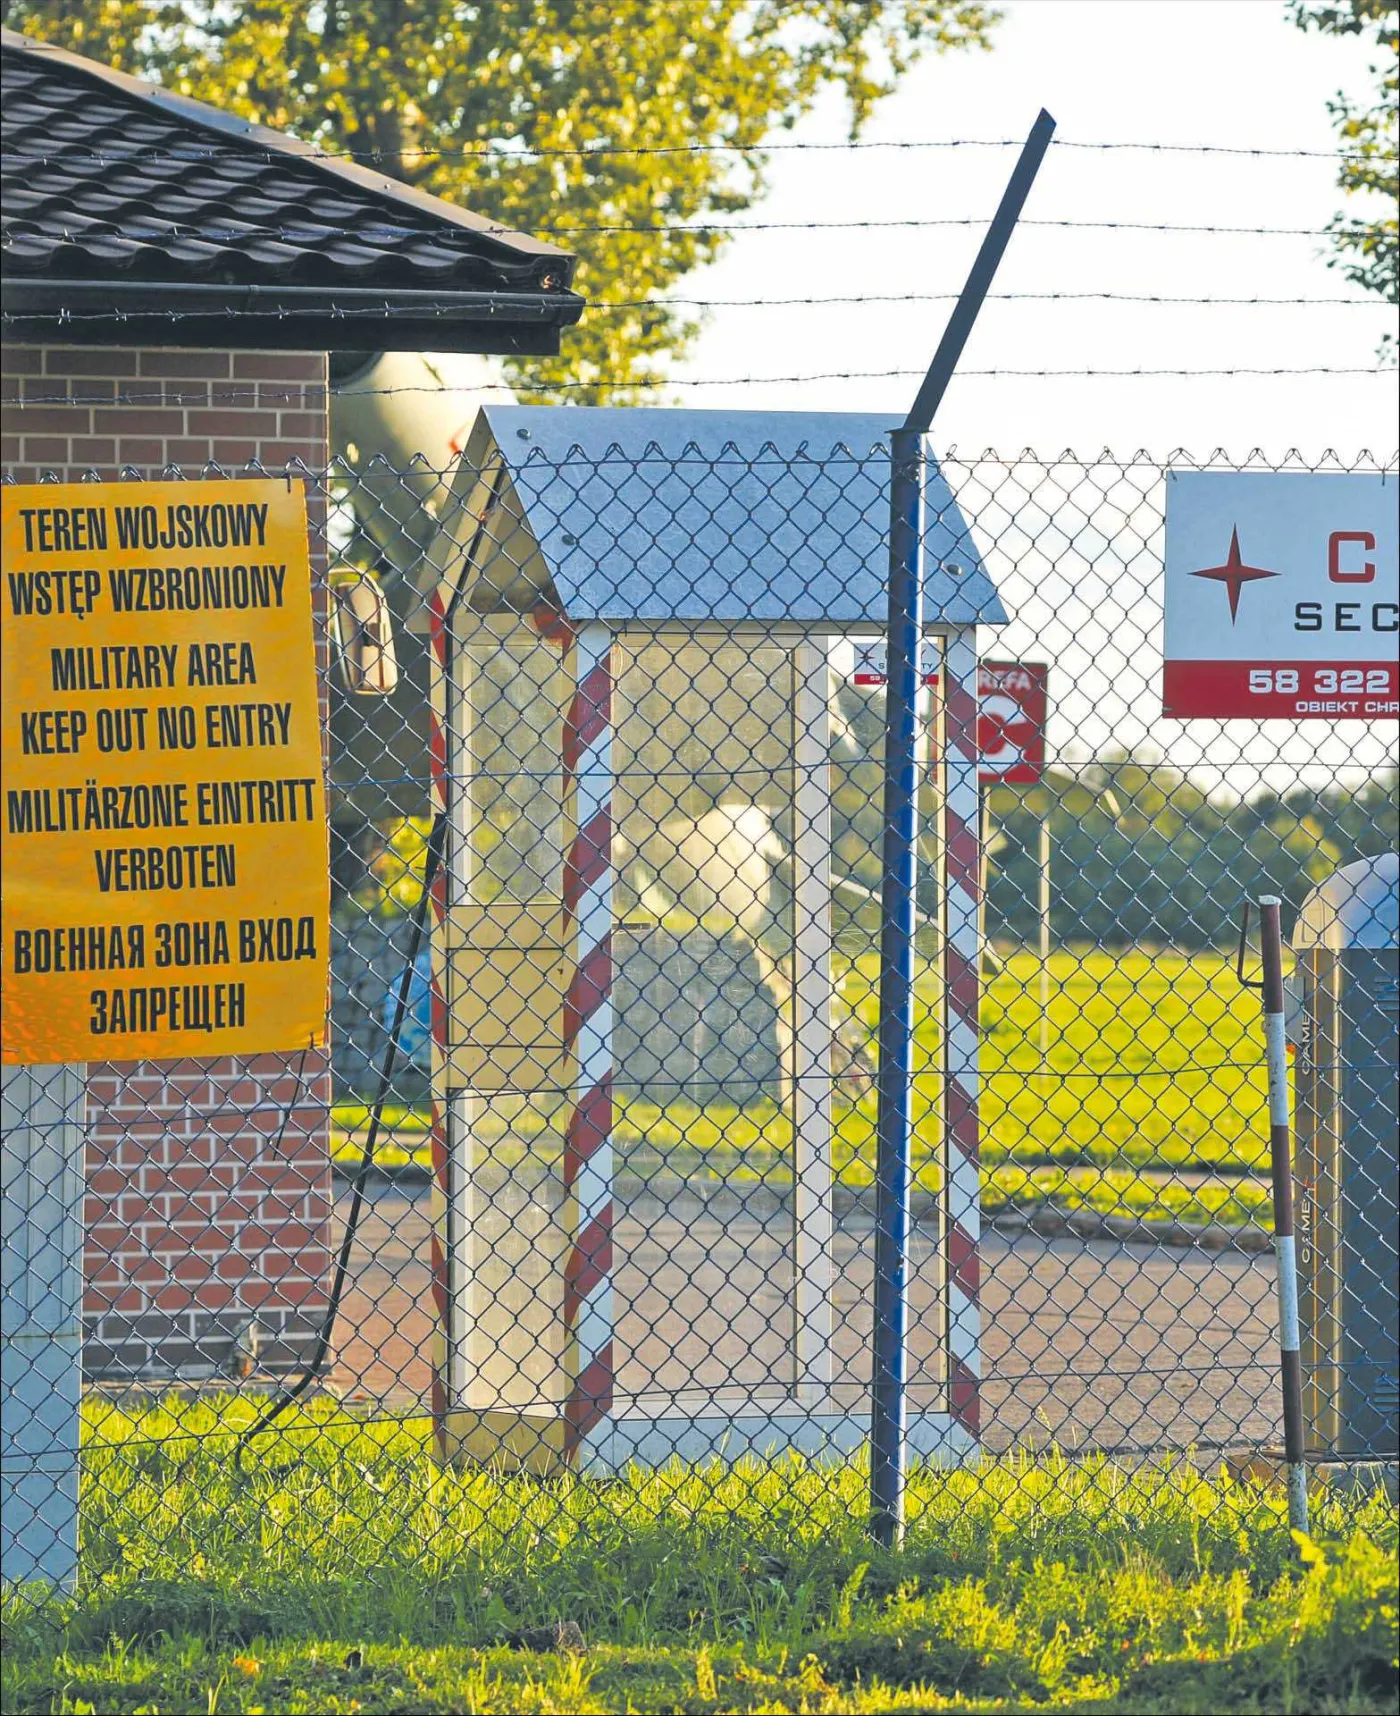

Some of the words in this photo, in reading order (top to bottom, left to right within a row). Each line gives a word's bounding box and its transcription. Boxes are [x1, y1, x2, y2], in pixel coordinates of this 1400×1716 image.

[20, 507, 108, 552] TEREN
[114, 503, 268, 549] WOJSKOWY
[1328, 531, 1376, 583] C
[7, 570, 101, 620] WSTĘP
[109, 565, 286, 612] WZBRONIONY
[1294, 602, 1399, 632] SEC
[51, 645, 178, 691] MILITARY
[188, 642, 257, 686] AREA
[1249, 669, 1299, 694] 58
[1314, 669, 1390, 694] 322
[21, 710, 87, 755] KEEP
[96, 708, 148, 753] OUT
[158, 706, 197, 750] NO
[205, 703, 292, 748] ENTRY
[1295, 701, 1359, 713] OBIEKT
[7, 779, 189, 834] MILITÄRZONE
[197, 779, 316, 825] EINTRITT
[95, 844, 237, 892] VERBOTEN
[13, 924, 145, 974] ВОЕННАЯ
[155, 921, 230, 967] ЗОНА
[239, 916, 317, 963] ВХОД
[90, 983, 245, 1035] ЗАПРЕЩЕН
